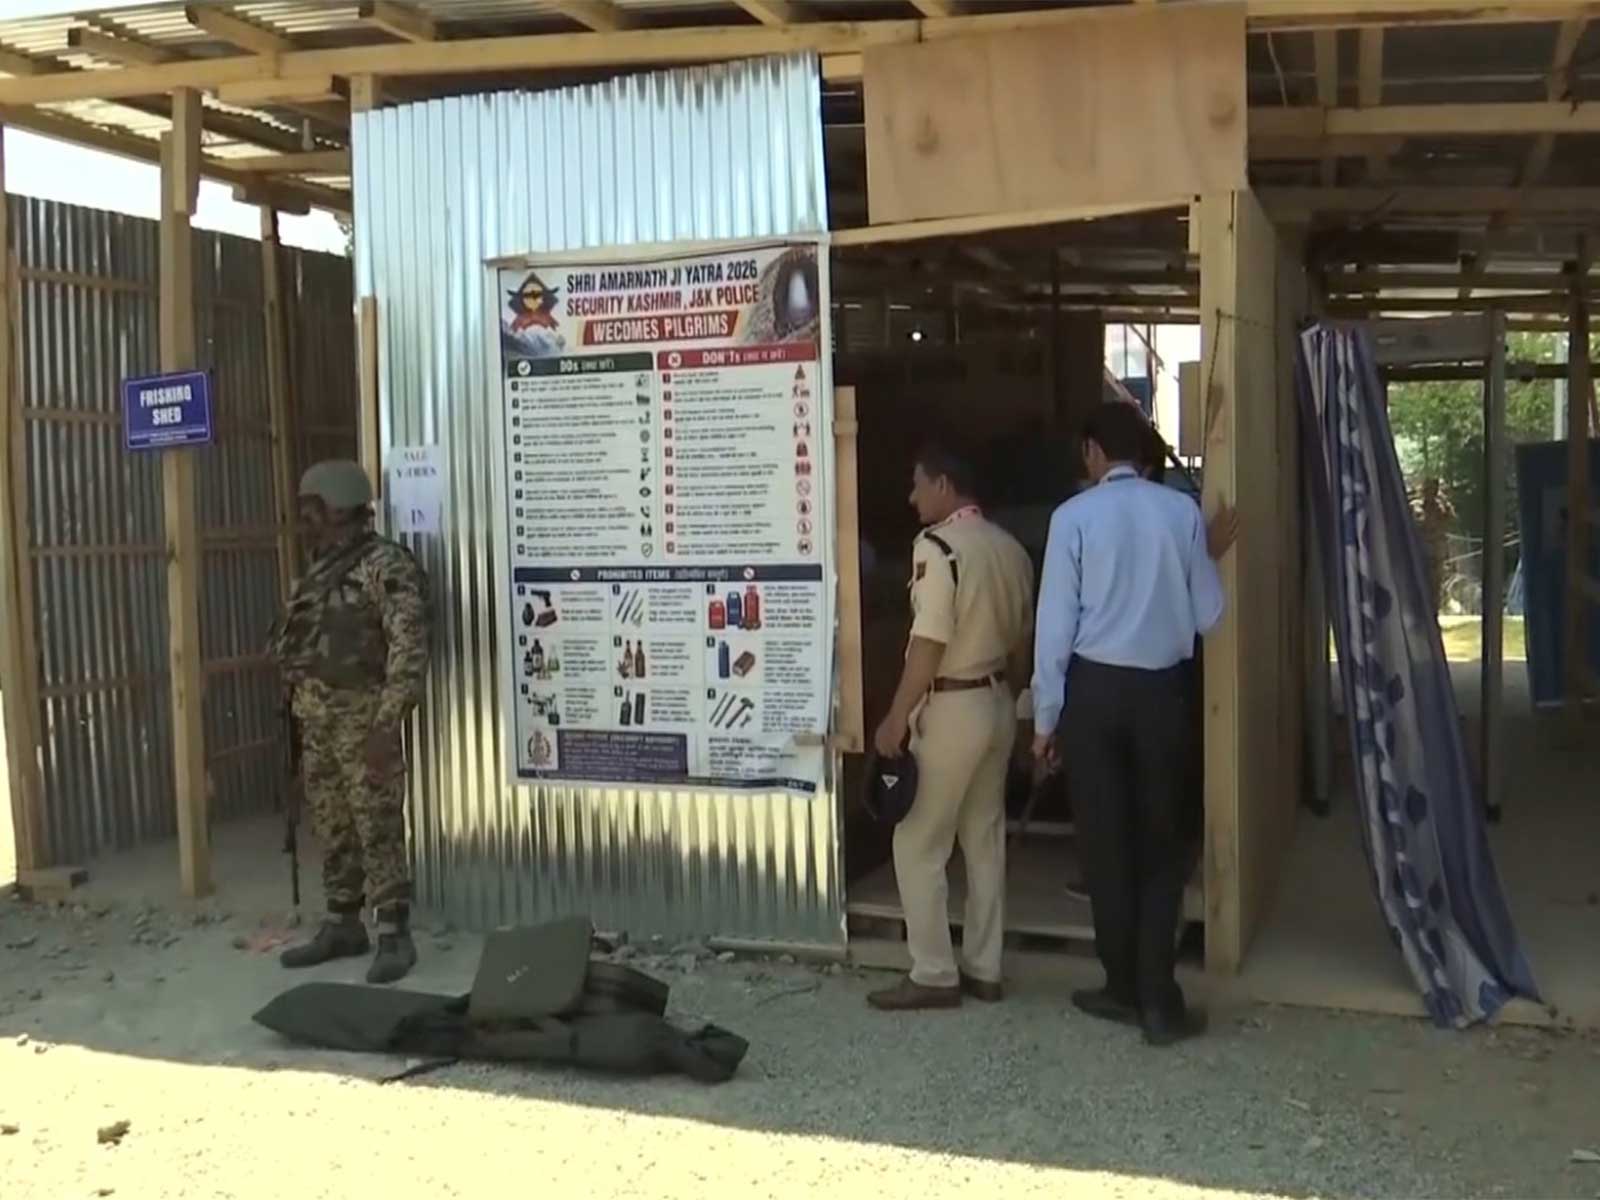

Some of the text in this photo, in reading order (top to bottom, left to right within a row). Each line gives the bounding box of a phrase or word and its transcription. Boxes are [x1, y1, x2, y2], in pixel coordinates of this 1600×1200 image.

[567, 259, 758, 294] SHRI AMARNATH JI YATRA 2026
[567, 295, 624, 317] SECURITY
[689, 288, 713, 308] J&K
[717, 284, 759, 306] POLICE
[593, 314, 729, 342] WECOMES PILGRIMS
[152, 406, 182, 426] SHED
[645, 569, 670, 581] ITEMS
